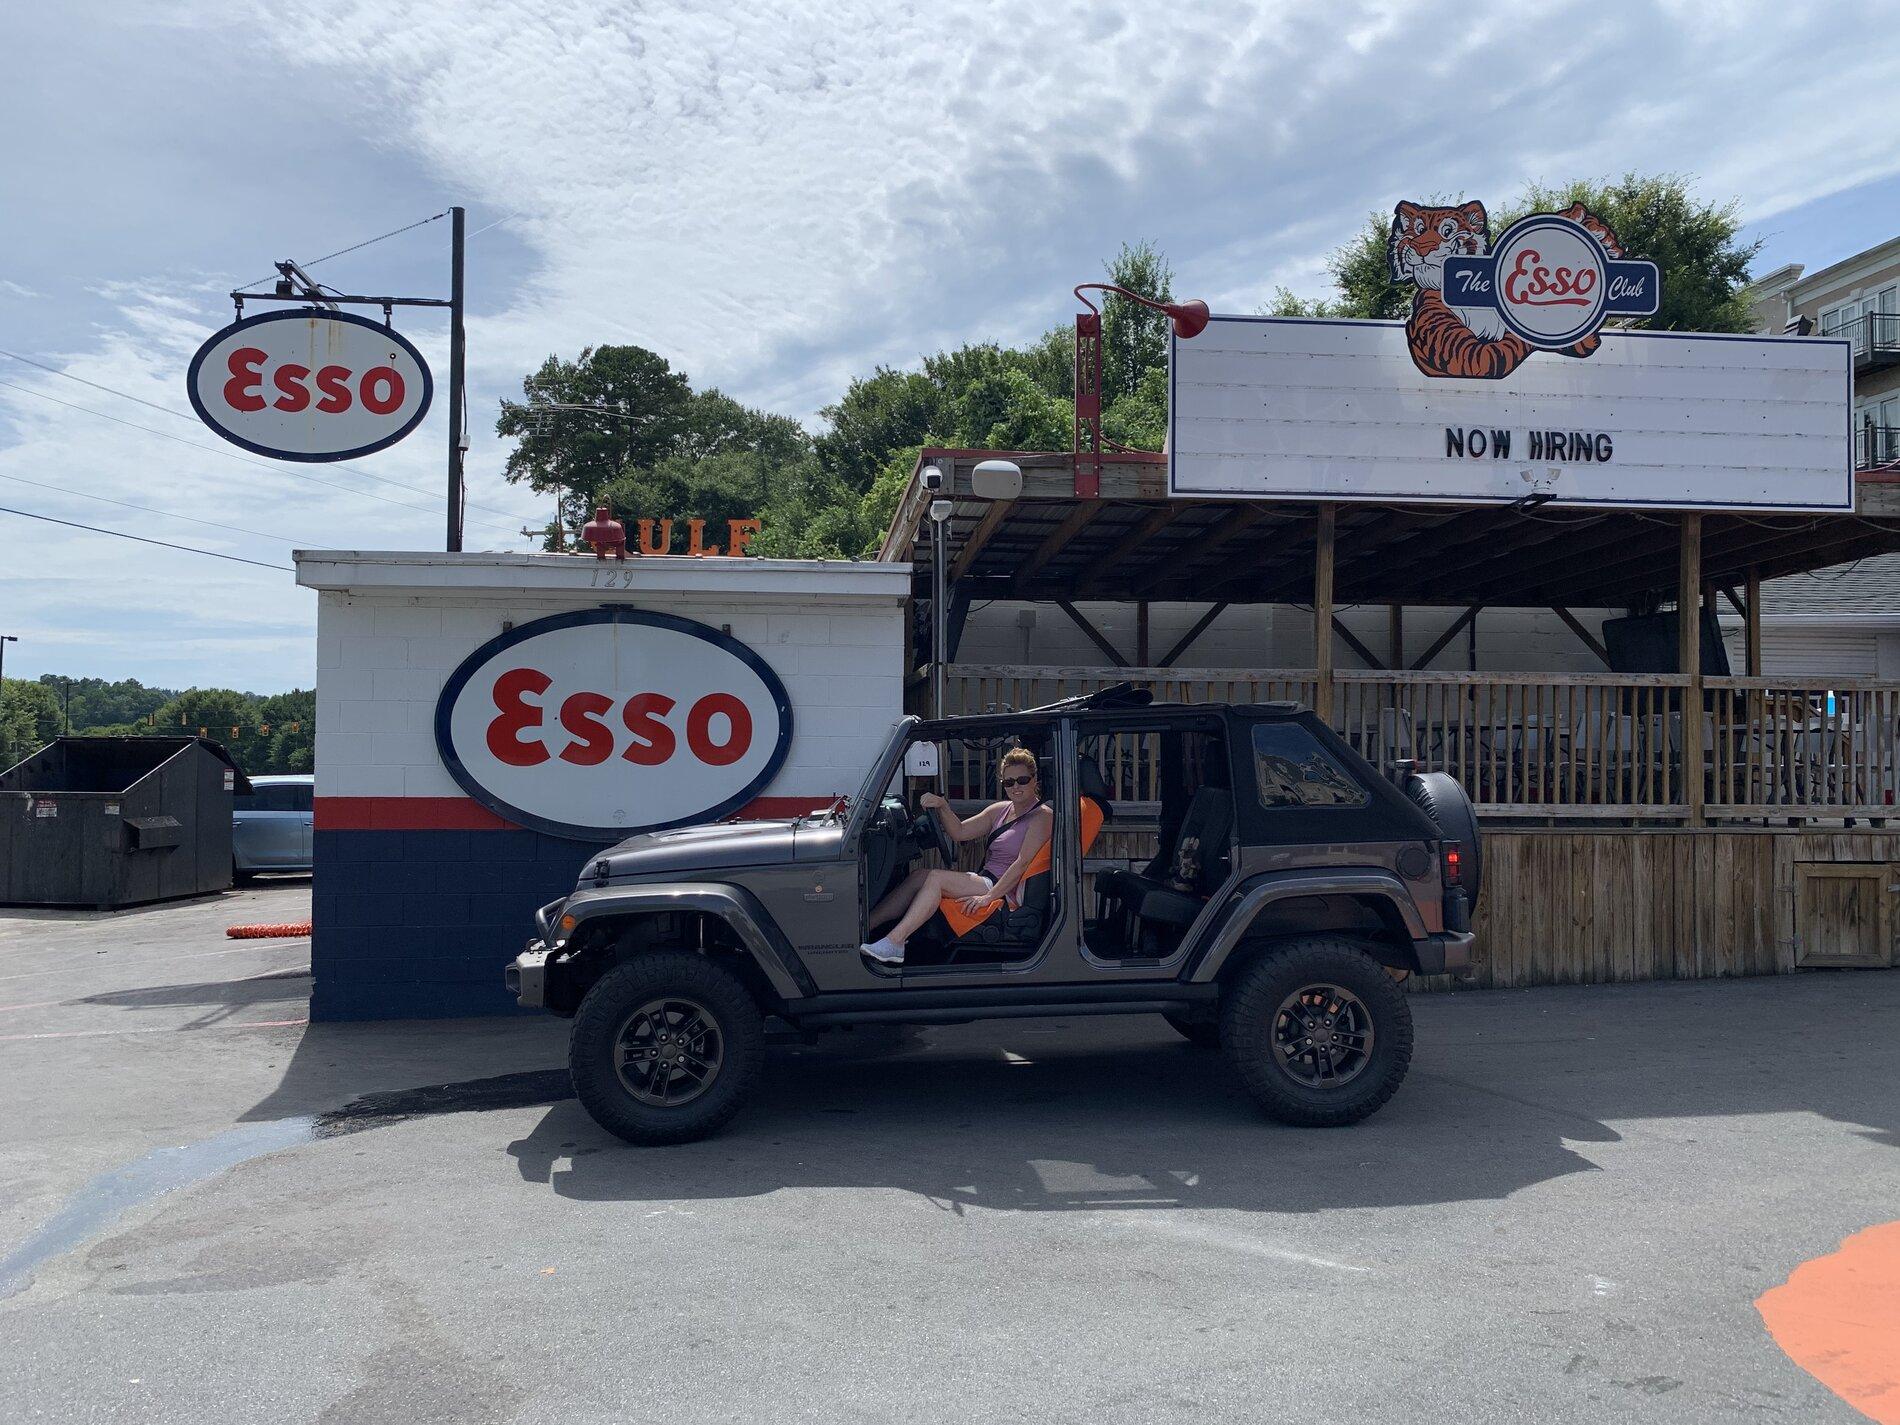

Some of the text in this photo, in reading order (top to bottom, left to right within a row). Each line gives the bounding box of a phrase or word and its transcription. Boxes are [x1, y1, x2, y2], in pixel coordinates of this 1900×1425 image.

[1455, 270, 1491, 293] The
[1607, 275, 1646, 301] Club
[1445, 427, 1614, 463] NOW HIRING
[591, 518, 762, 557] ULF
[590, 568, 634, 589] 129
